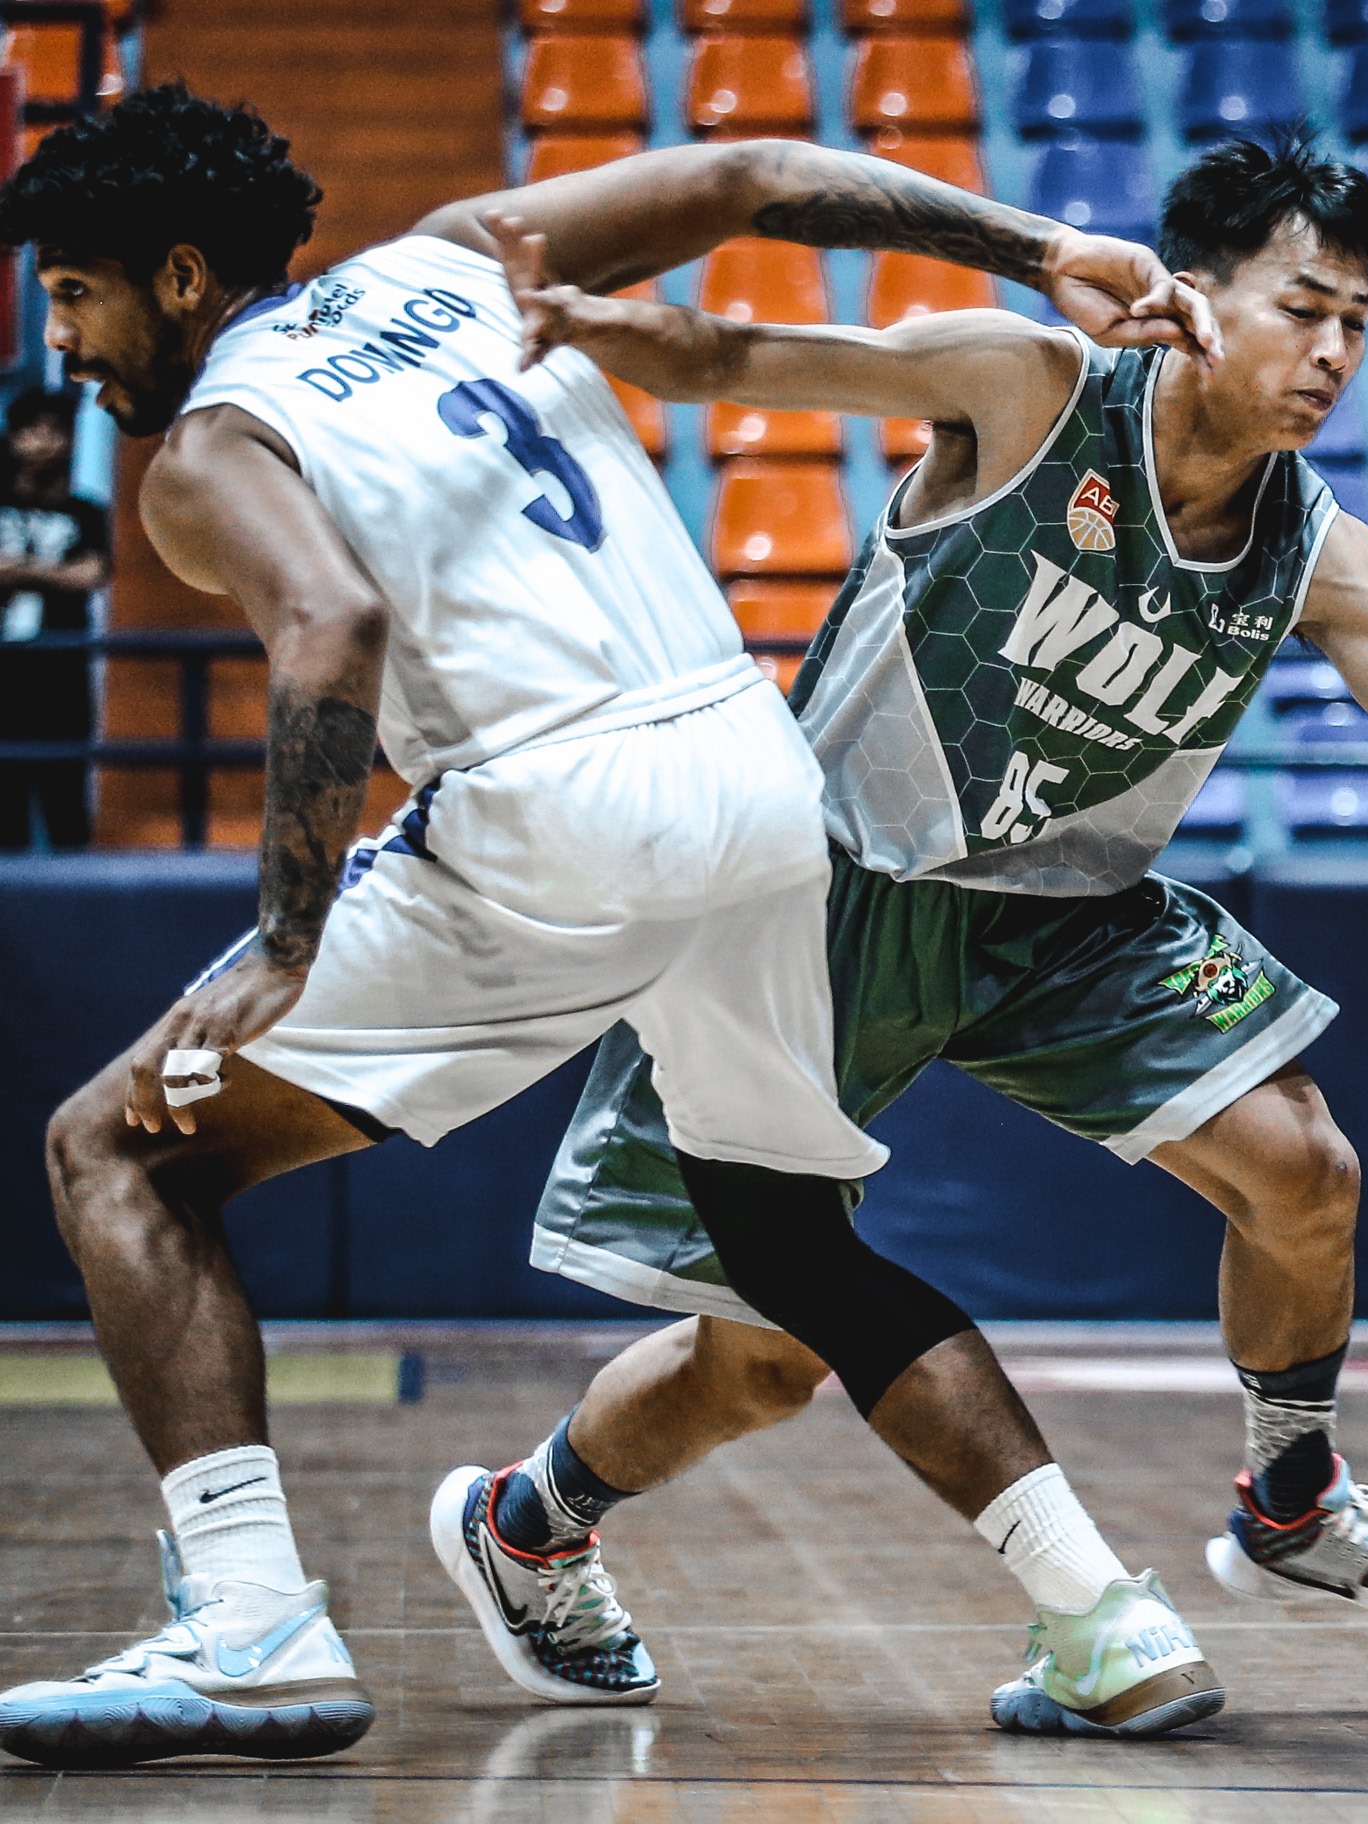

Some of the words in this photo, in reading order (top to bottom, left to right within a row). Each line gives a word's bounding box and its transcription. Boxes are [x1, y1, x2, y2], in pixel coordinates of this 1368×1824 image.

[437, 377, 604, 553] 3
[1227, 625, 1270, 641] Bolis
[1229, 612, 1274, 630] 宝利
[1014, 676, 1143, 750] WARRIORS
[980, 751, 1070, 844] 85
